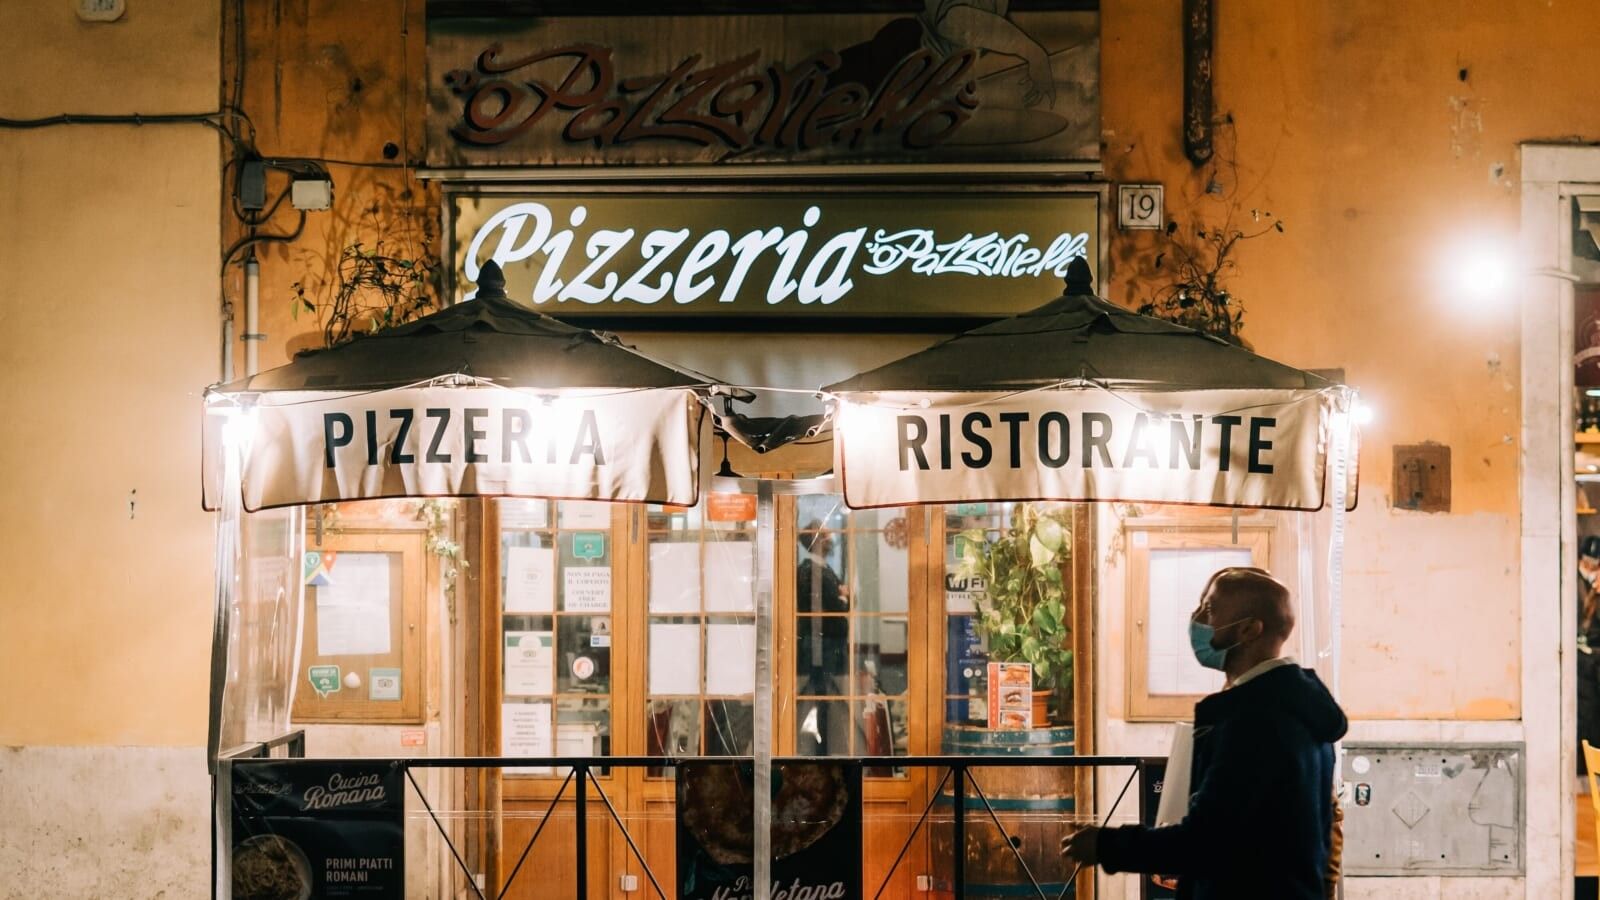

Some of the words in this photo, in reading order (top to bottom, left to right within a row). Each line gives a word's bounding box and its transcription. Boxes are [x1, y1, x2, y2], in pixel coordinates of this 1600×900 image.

[1129, 194, 1155, 220] 19
[464, 202, 868, 304] Pizzeria
[323, 407, 607, 469] PIZZERIA
[897, 411, 1277, 474] RISTORANTE
[328, 771, 380, 792] Cucina
[300, 785, 386, 812] Romana
[325, 857, 357, 870] PRIMI
[359, 857, 393, 870] PIATTI
[325, 870, 369, 883] ROMANI
